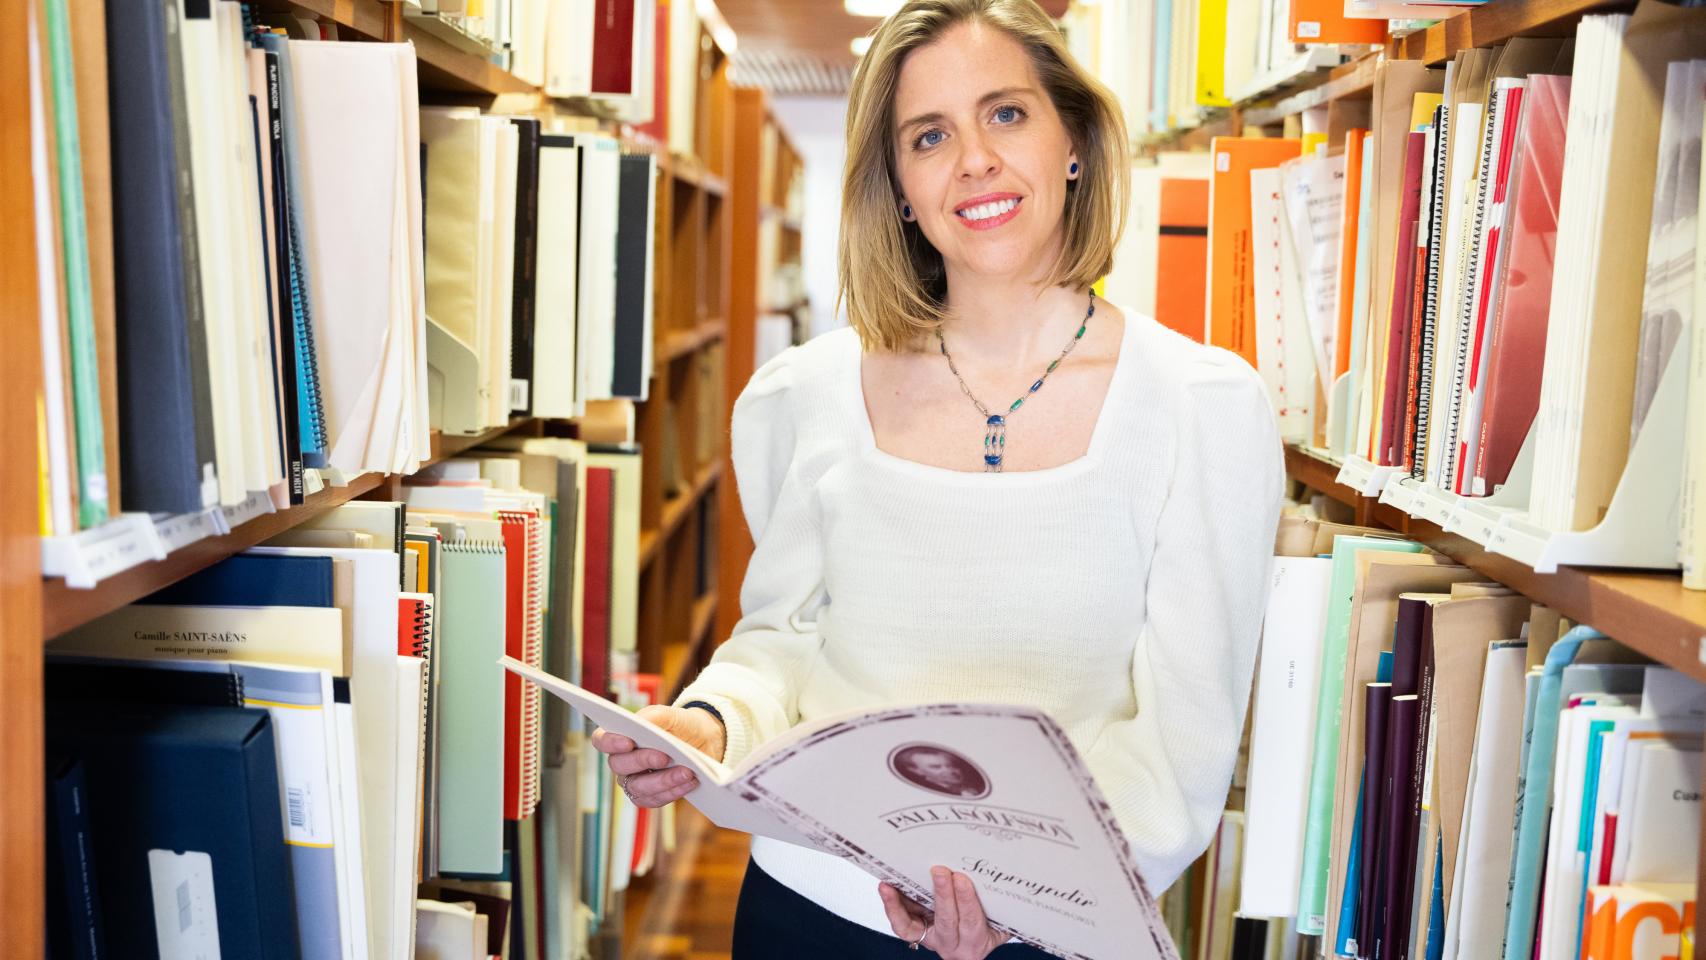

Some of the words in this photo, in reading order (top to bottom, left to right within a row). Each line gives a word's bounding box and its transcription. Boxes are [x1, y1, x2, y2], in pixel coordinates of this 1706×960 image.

[271, 82, 279, 109] PUCCINI
[292, 460, 302, 495] RICORDI
[134, 630, 170, 641] Camille
[173, 630, 248, 643] SAINT-SAËNS
[154, 647, 185, 655] musique
[187, 647, 205, 655] pour
[207, 647, 228, 655] piano
